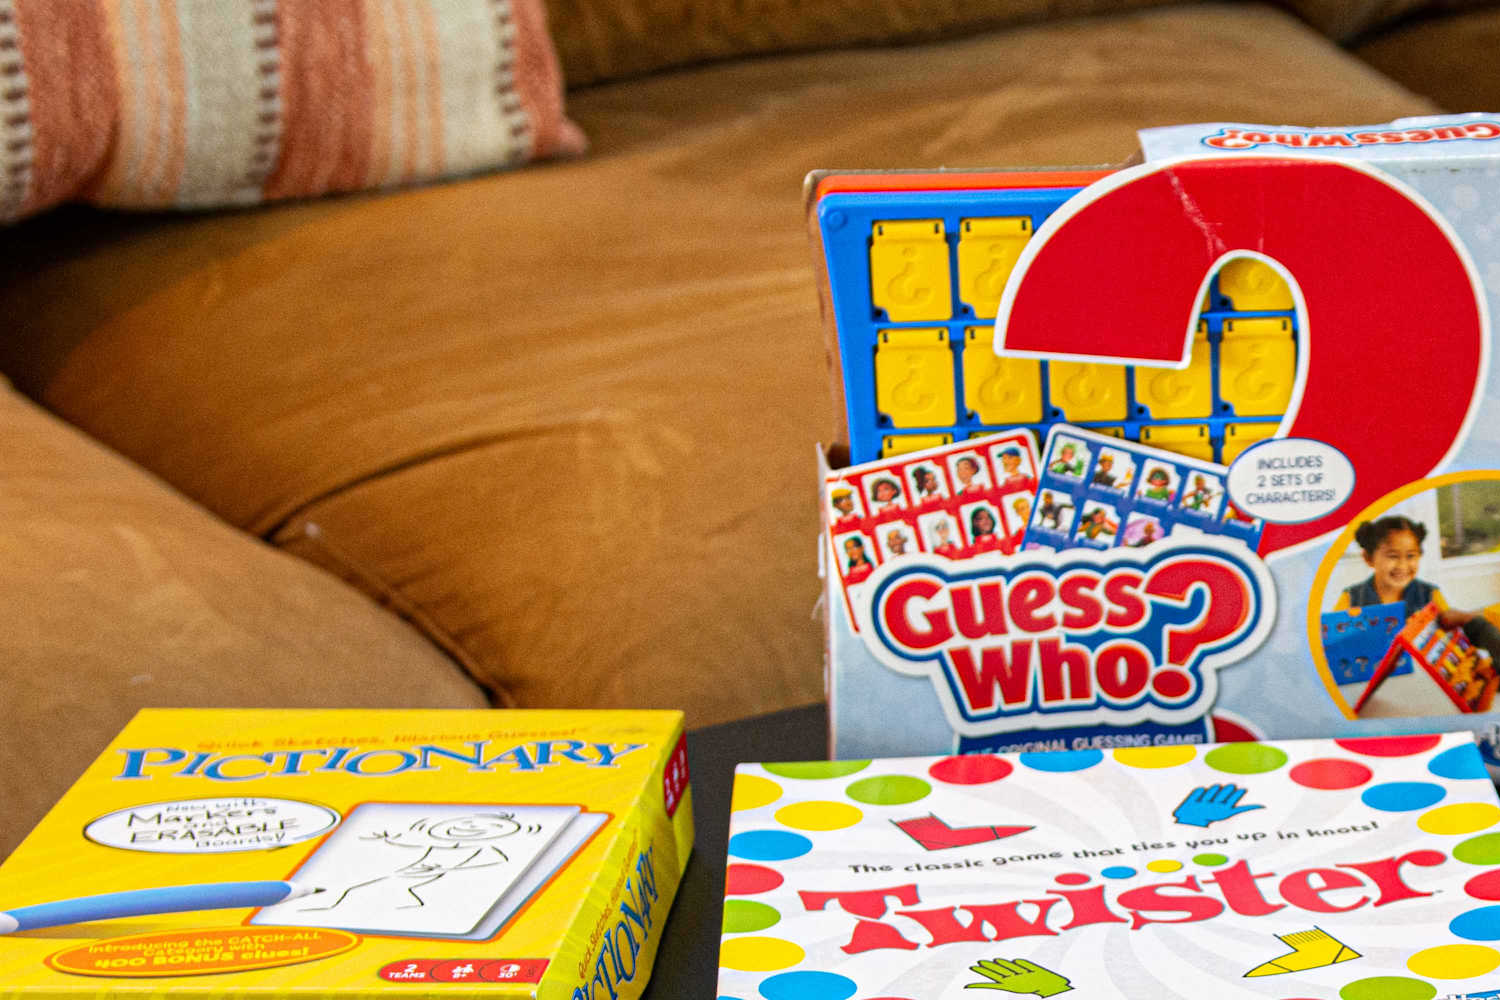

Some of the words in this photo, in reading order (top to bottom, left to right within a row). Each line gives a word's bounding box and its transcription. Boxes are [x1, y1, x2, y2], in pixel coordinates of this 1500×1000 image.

[1257, 455, 1324, 470] INCLUDES
[1257, 475, 1267, 487] 2
[1271, 473, 1303, 487] SETS
[1306, 472, 1325, 485] OF
[1246, 487, 1337, 505] CHARACTERS!
[1072, 734, 1150, 752] GUESSING
[1154, 733, 1204, 746] GAME!
[112, 738, 648, 782] PICTIONARY
[127, 807, 278, 828] Markers
[130, 817, 301, 844] ERASABLE
[849, 863, 893, 874] The
[903, 857, 986, 873] classic
[993, 850, 1064, 866] game
[1072, 847, 1128, 861] that
[1131, 839, 1177, 853] ties
[1185, 835, 1230, 850] you
[1237, 831, 1269, 843] up
[1277, 829, 1301, 840] in
[1306, 820, 1382, 839] knots!
[797, 847, 1448, 956] Twister
[227, 931, 322, 945] CATCH-ALL
[94, 956, 147, 970] 400
[151, 951, 236, 967] BONUS
[387, 971, 428, 979] TEAMS
